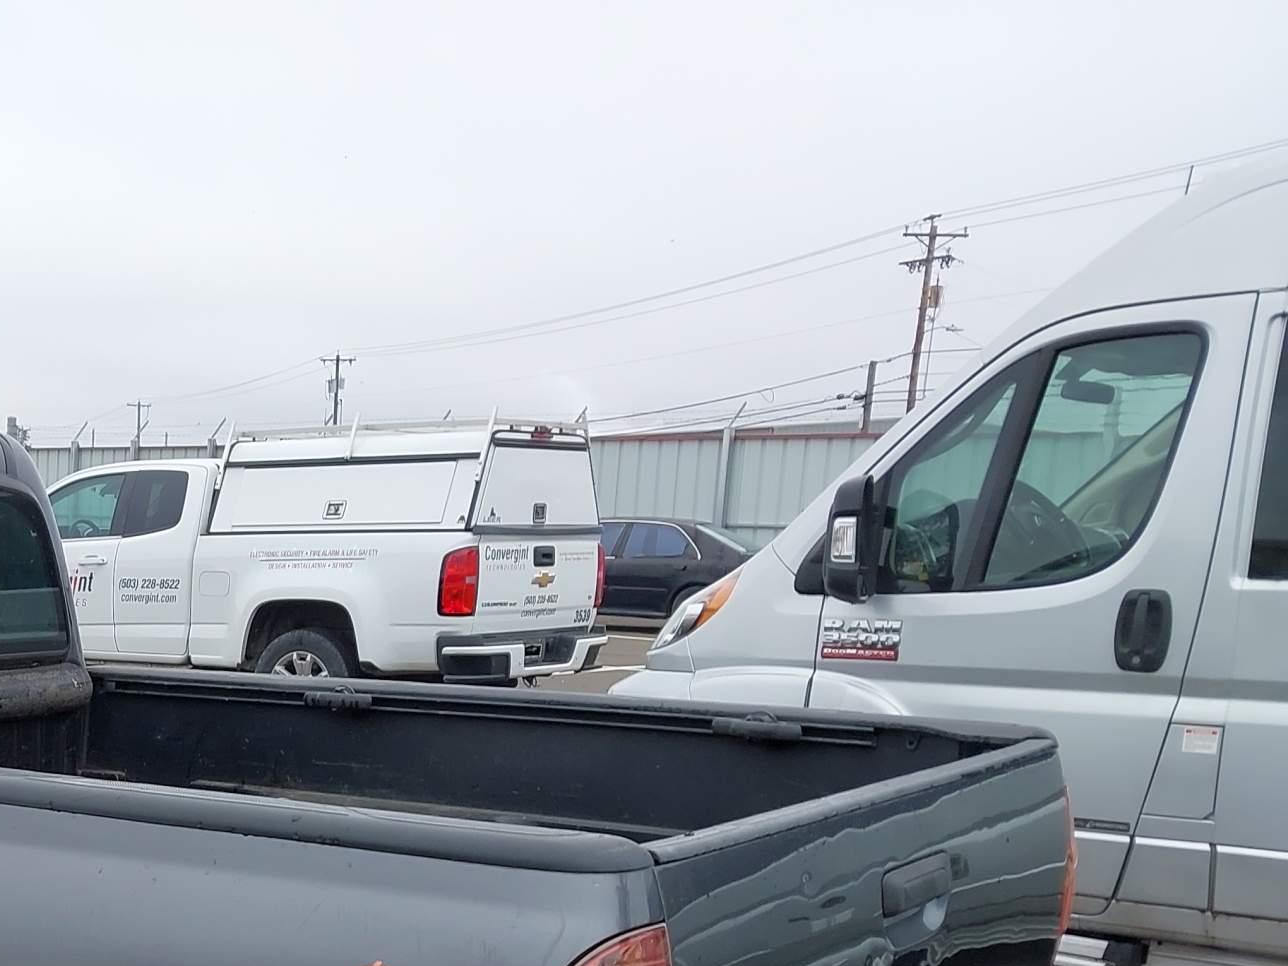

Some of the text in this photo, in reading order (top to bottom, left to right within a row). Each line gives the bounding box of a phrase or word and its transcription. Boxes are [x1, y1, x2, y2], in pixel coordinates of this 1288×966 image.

[485, 544, 529, 563] Convergint
[118, 578, 180, 592] (503) 228-8522
[120, 593, 177, 605] convergint.com
[573, 608, 591, 623] 3539
[823, 618, 903, 633] RAM
[823, 632, 901, 648] 3500
